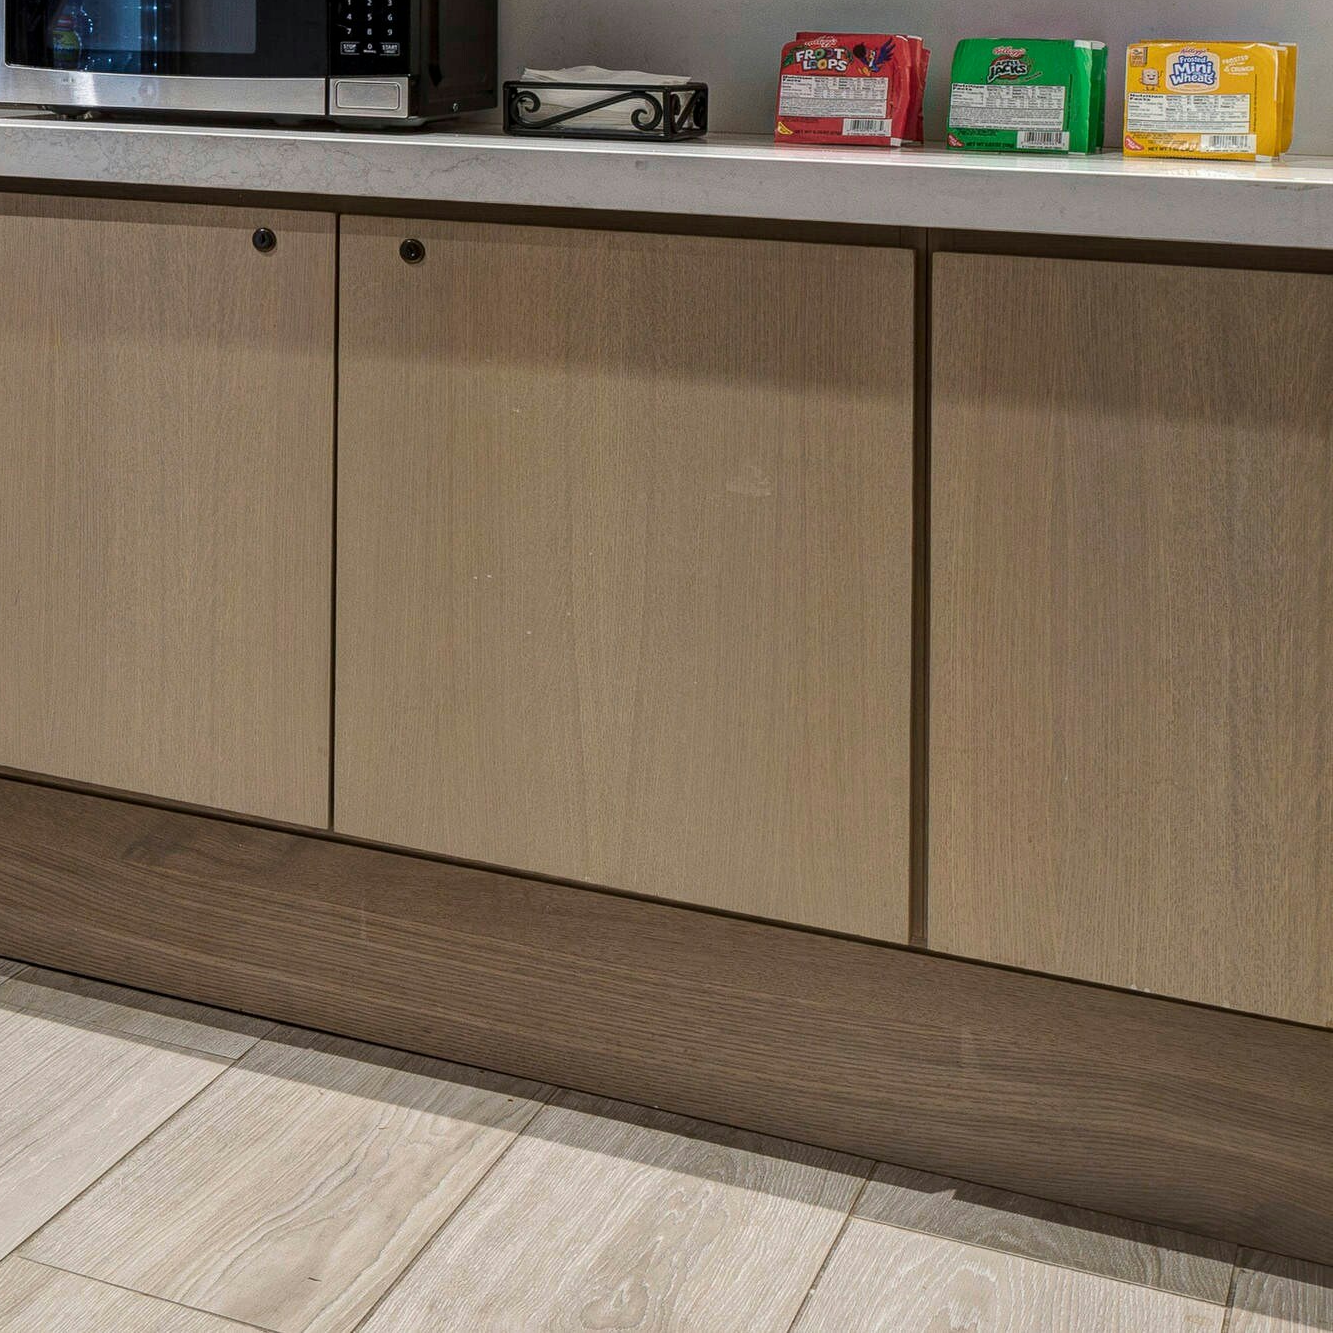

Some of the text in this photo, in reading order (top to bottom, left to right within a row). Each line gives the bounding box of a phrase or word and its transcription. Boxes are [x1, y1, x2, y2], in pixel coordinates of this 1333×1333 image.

[795, 47, 846, 64] FROOT
[992, 46, 1027, 58] Kellogg's
[802, 58, 848, 72] LOOPS
[1178, 55, 1207, 64] Frosted
[987, 64, 1028, 83] JACKS
[1173, 62, 1212, 74] Mini
[1170, 72, 1215, 85] Wheats
